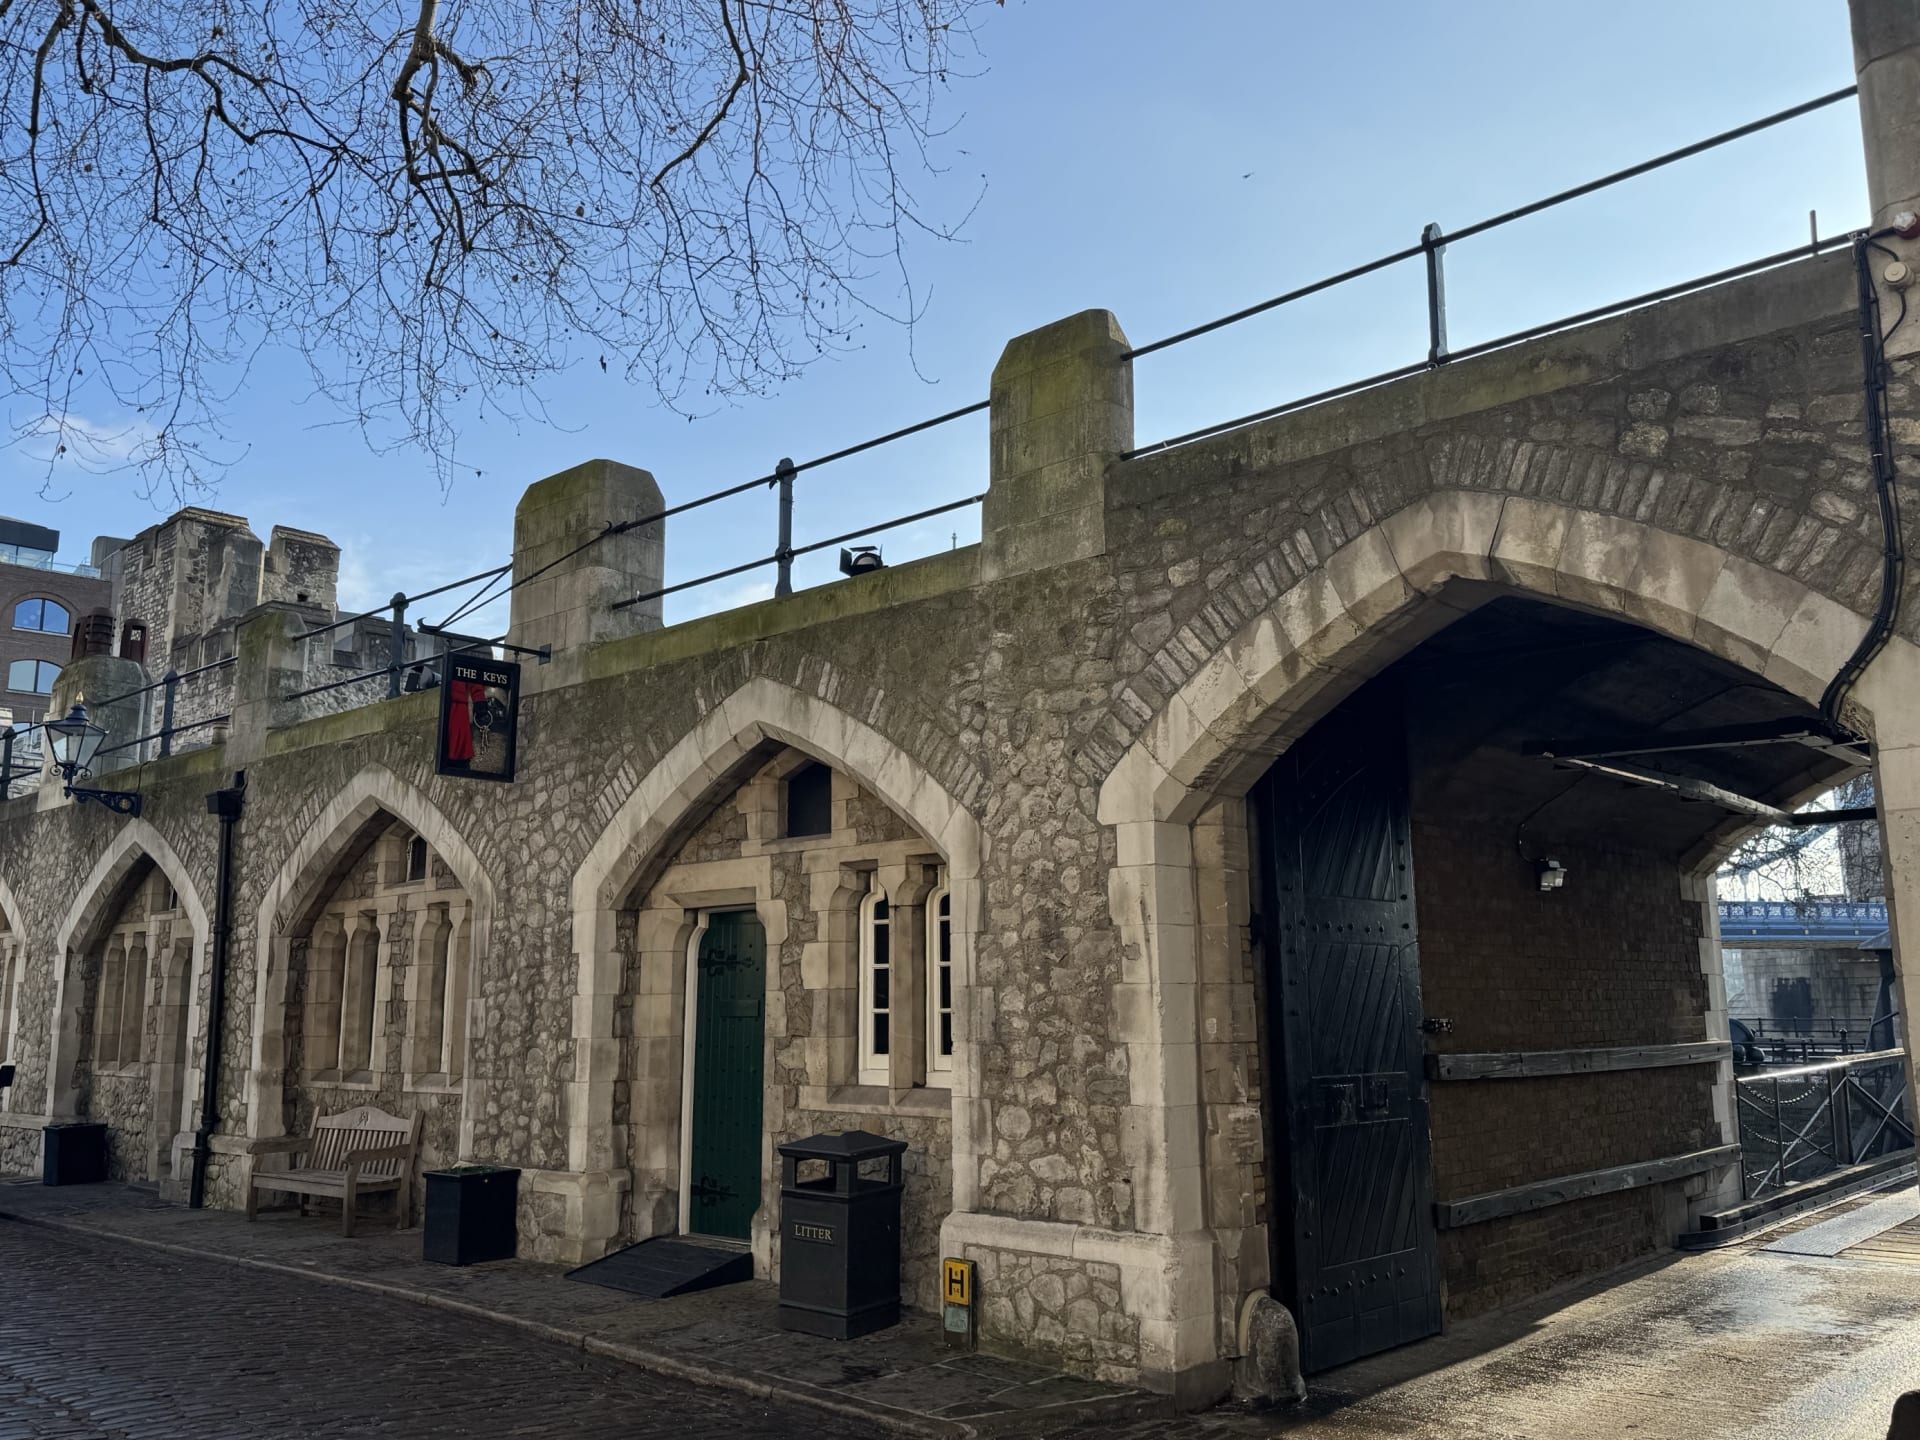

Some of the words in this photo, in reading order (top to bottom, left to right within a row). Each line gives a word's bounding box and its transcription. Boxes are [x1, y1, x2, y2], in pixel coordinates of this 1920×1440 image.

[455, 666, 477, 679] THE
[483, 671, 508, 685] KEYS
[794, 1224, 832, 1241] LITTER
[948, 1267, 964, 1298] H
